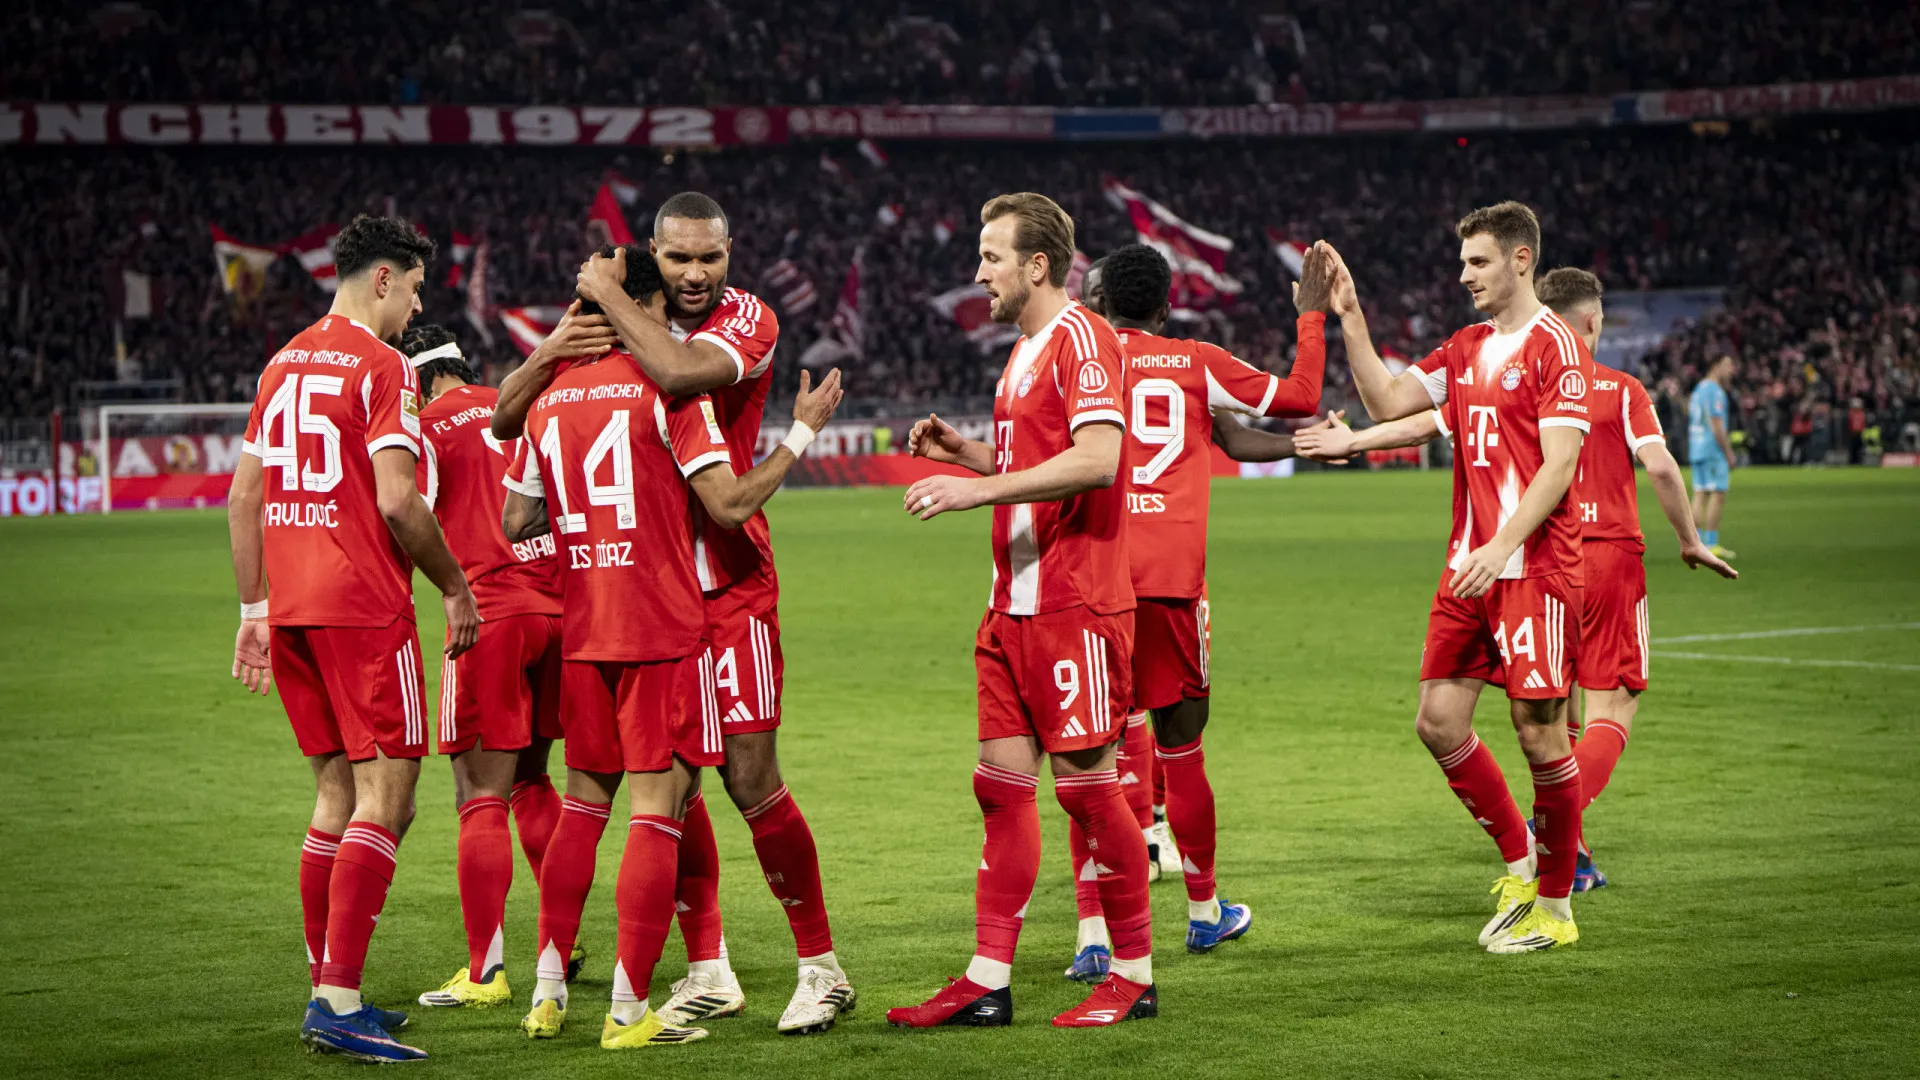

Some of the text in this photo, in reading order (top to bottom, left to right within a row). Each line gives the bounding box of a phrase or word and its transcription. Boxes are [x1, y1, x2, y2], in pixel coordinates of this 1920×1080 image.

[469, 105, 714, 143] 1972
[432, 420, 452, 435] FC
[449, 405, 495, 427] BAYERN
[537, 395, 549, 412] FC
[548, 387, 586, 407] BAYERN
[1076, 396, 1115, 410] Allianz
[1556, 401, 1589, 414] Allianz
[262, 373, 345, 492] 45
[1131, 378, 1186, 485] 9
[539, 409, 637, 535] 14
[595, 538, 635, 568] DÍAZ
[1493, 616, 1537, 665] 44
[715, 646, 740, 697] 4
[1053, 659, 1080, 710] 9
